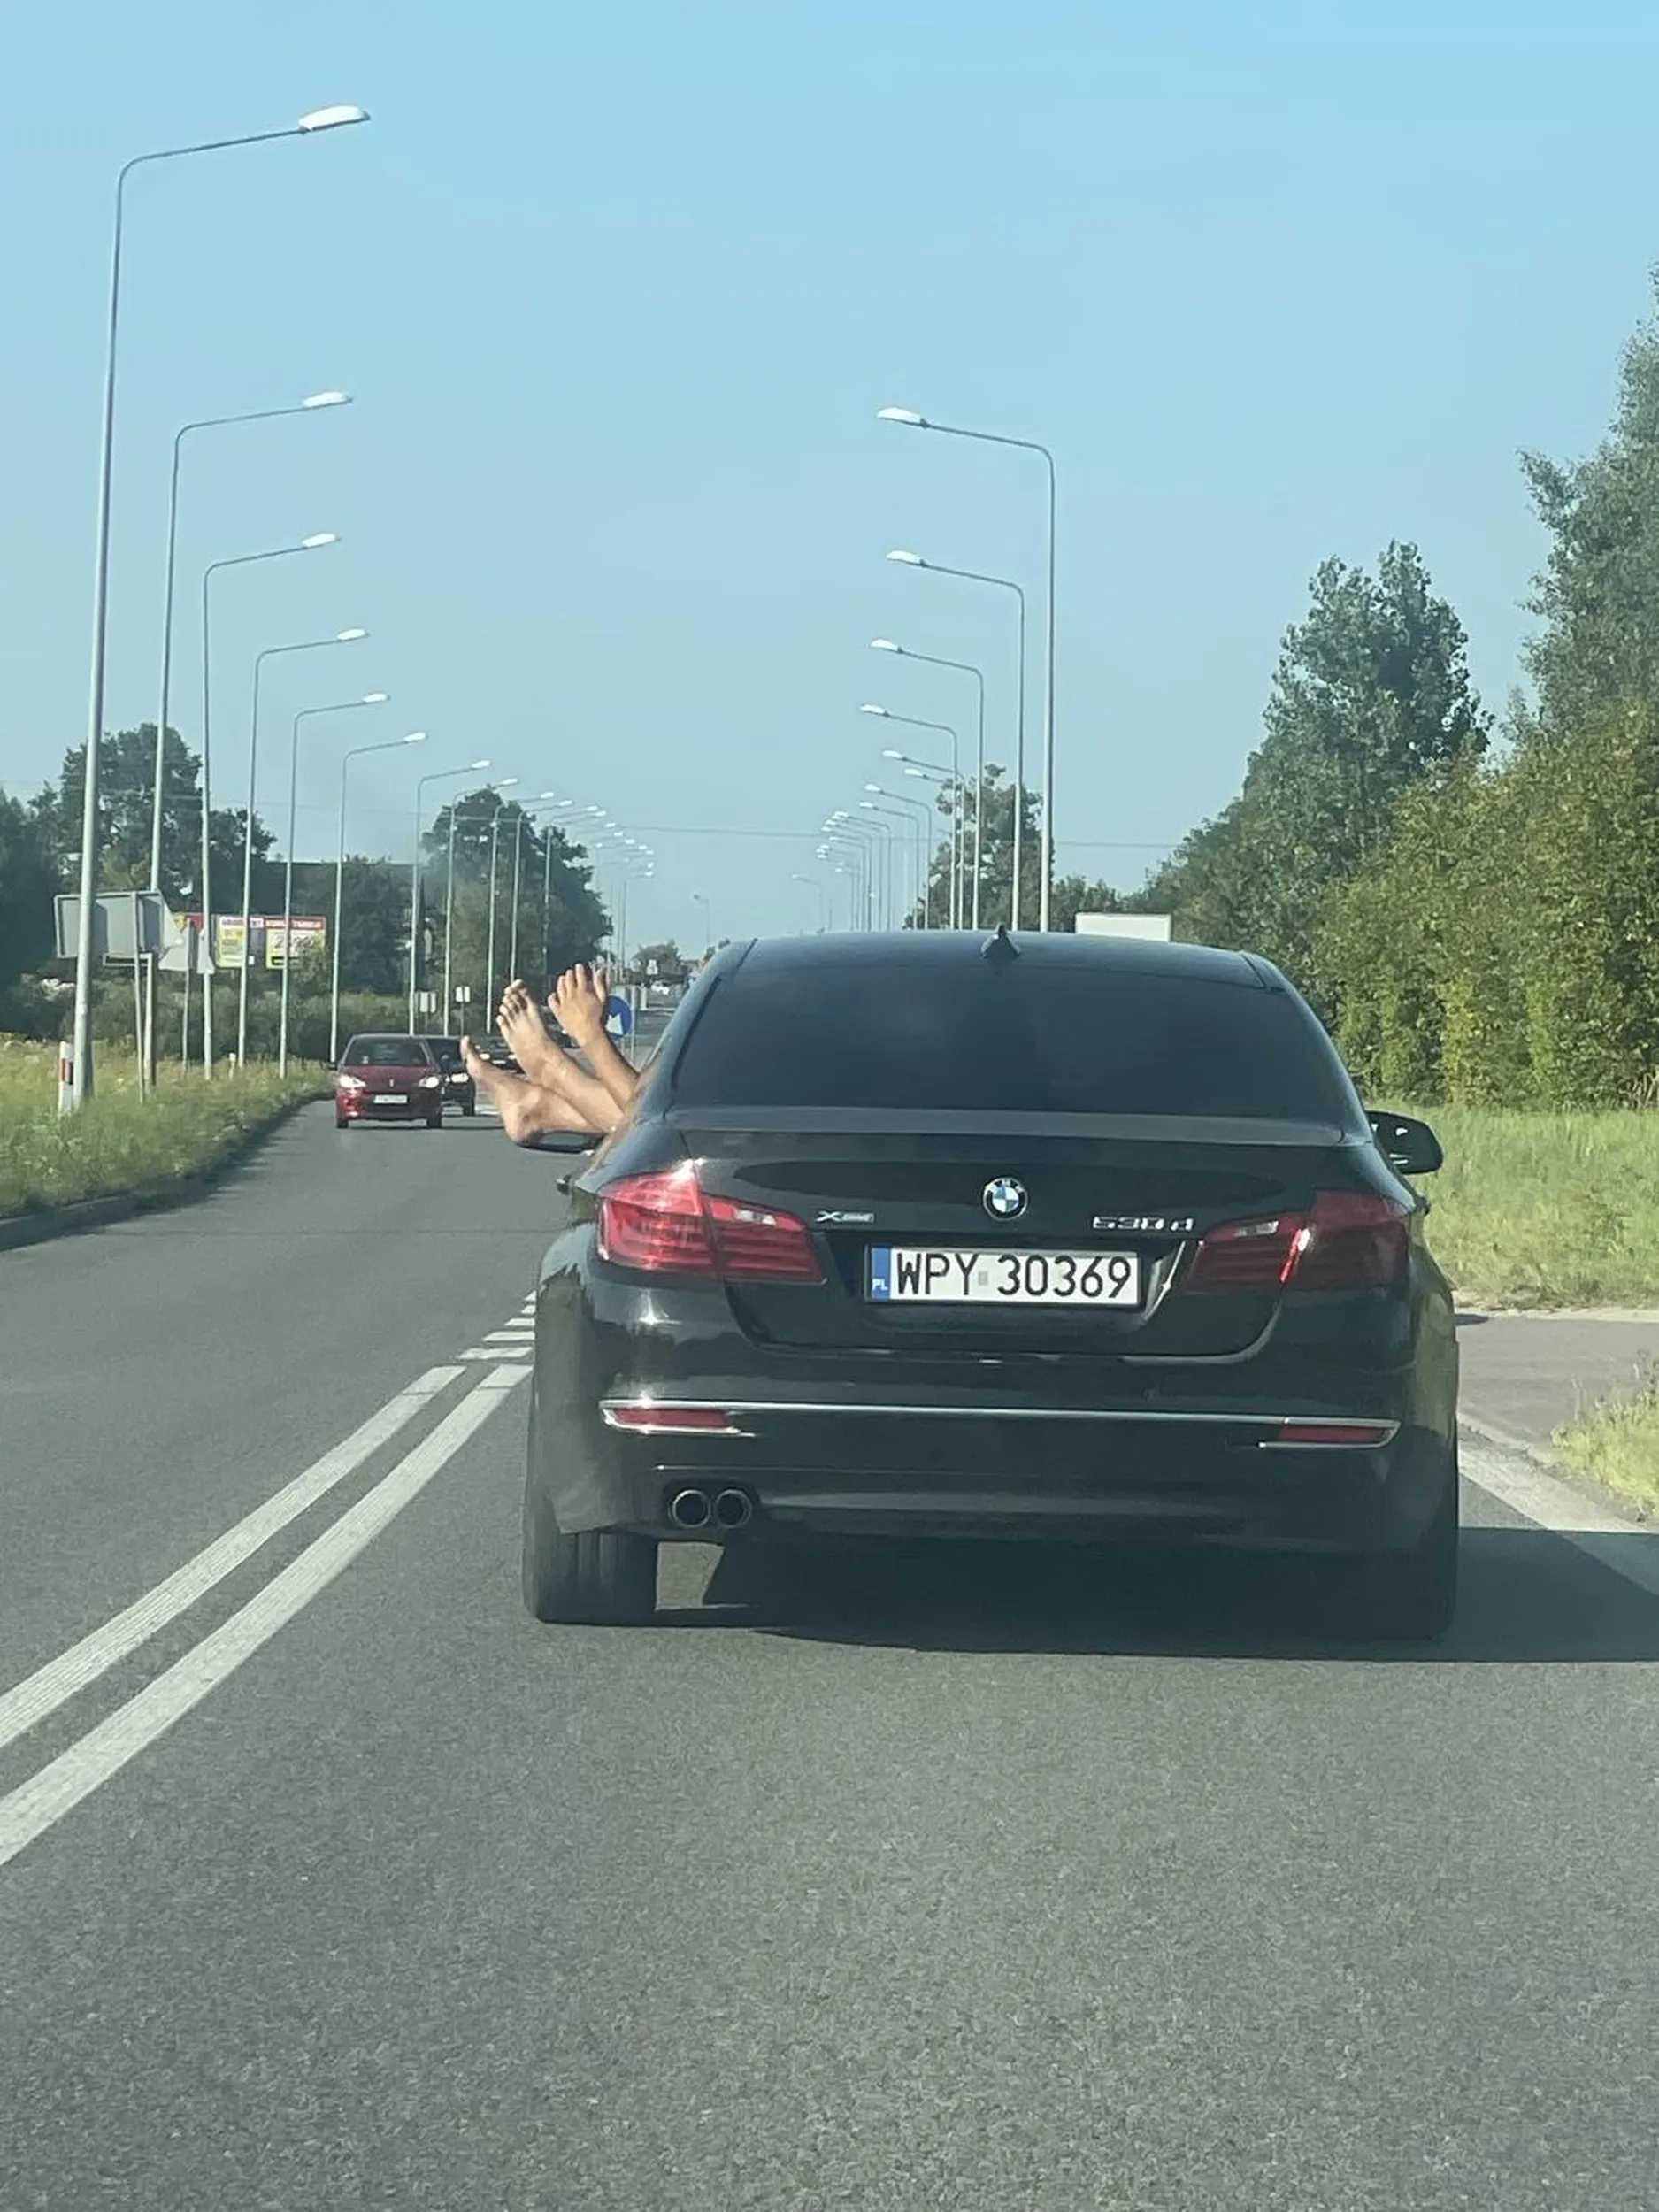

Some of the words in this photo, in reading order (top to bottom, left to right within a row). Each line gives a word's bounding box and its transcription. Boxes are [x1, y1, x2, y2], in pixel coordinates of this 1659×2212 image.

[872, 1279, 888, 1291] PL
[896, 1252, 979, 1295] WPY
[997, 1254, 1131, 1298] 30369
